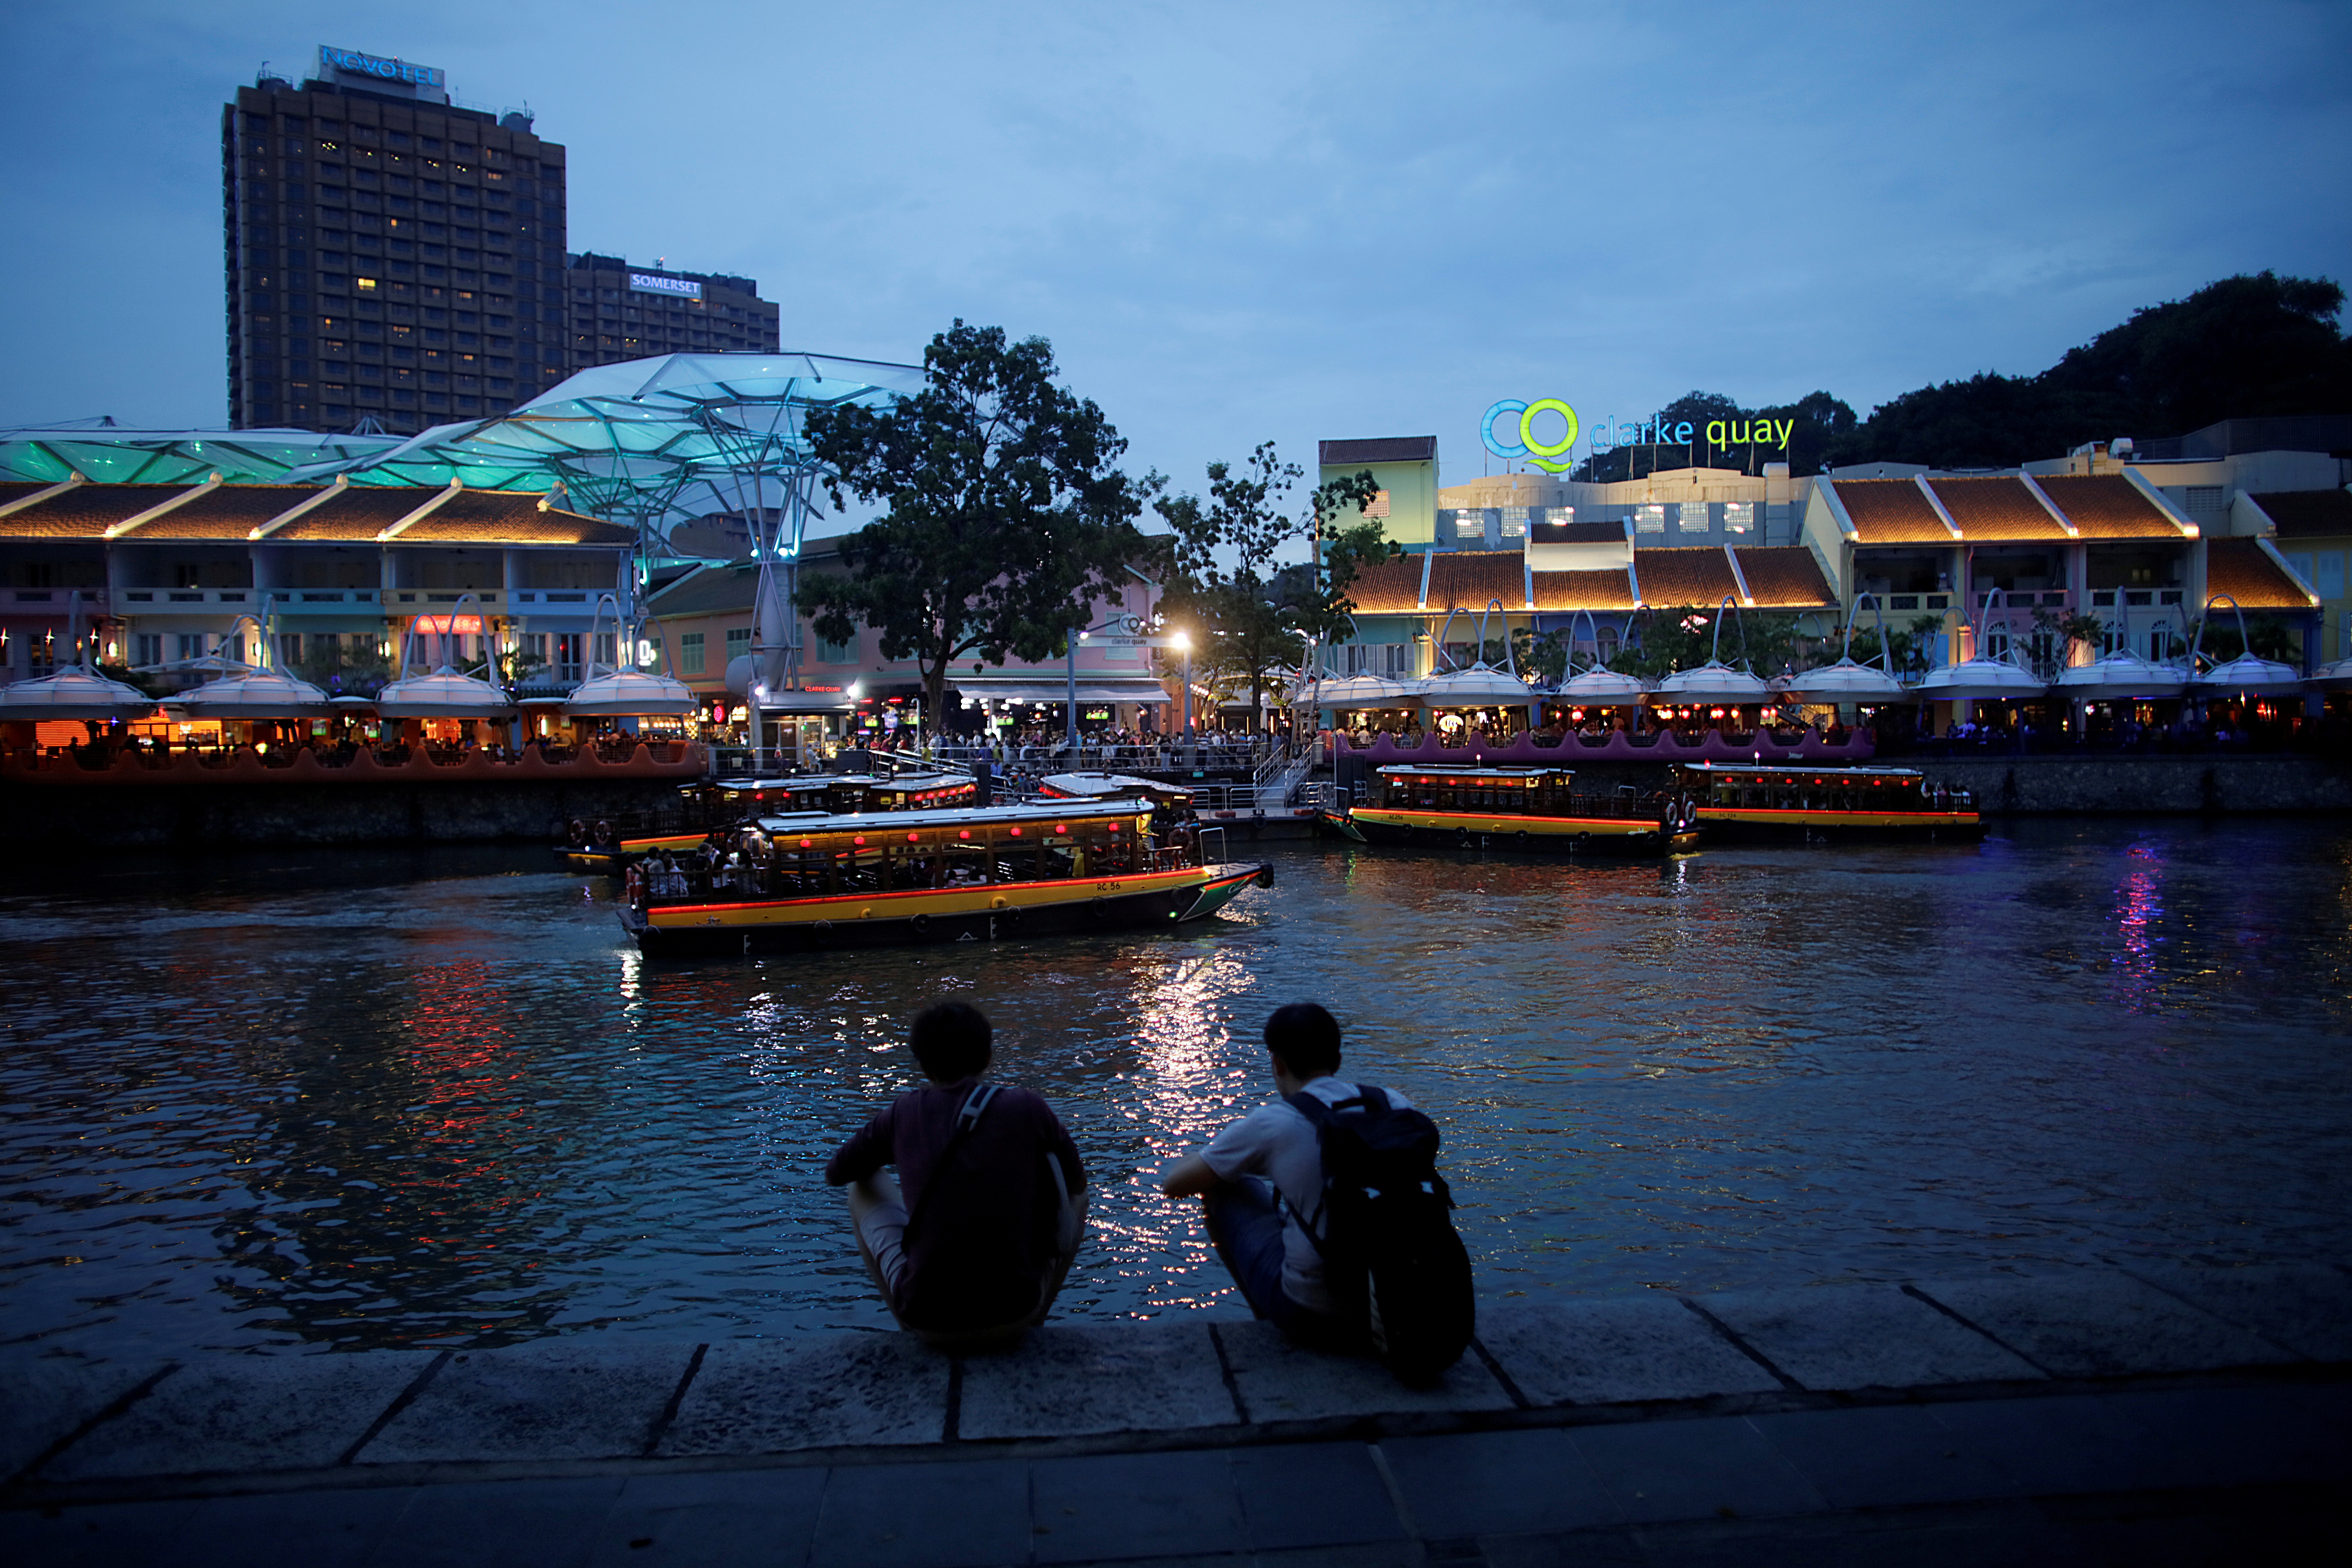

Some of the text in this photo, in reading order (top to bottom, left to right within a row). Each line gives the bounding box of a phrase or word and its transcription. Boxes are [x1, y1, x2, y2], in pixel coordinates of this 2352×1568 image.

[323, 46, 441, 87] NOVOTEL
[632, 274, 701, 293] SOMERSET
[1590, 414, 1795, 452] clarke quay
[1097, 882, 1120, 891] RC 56
